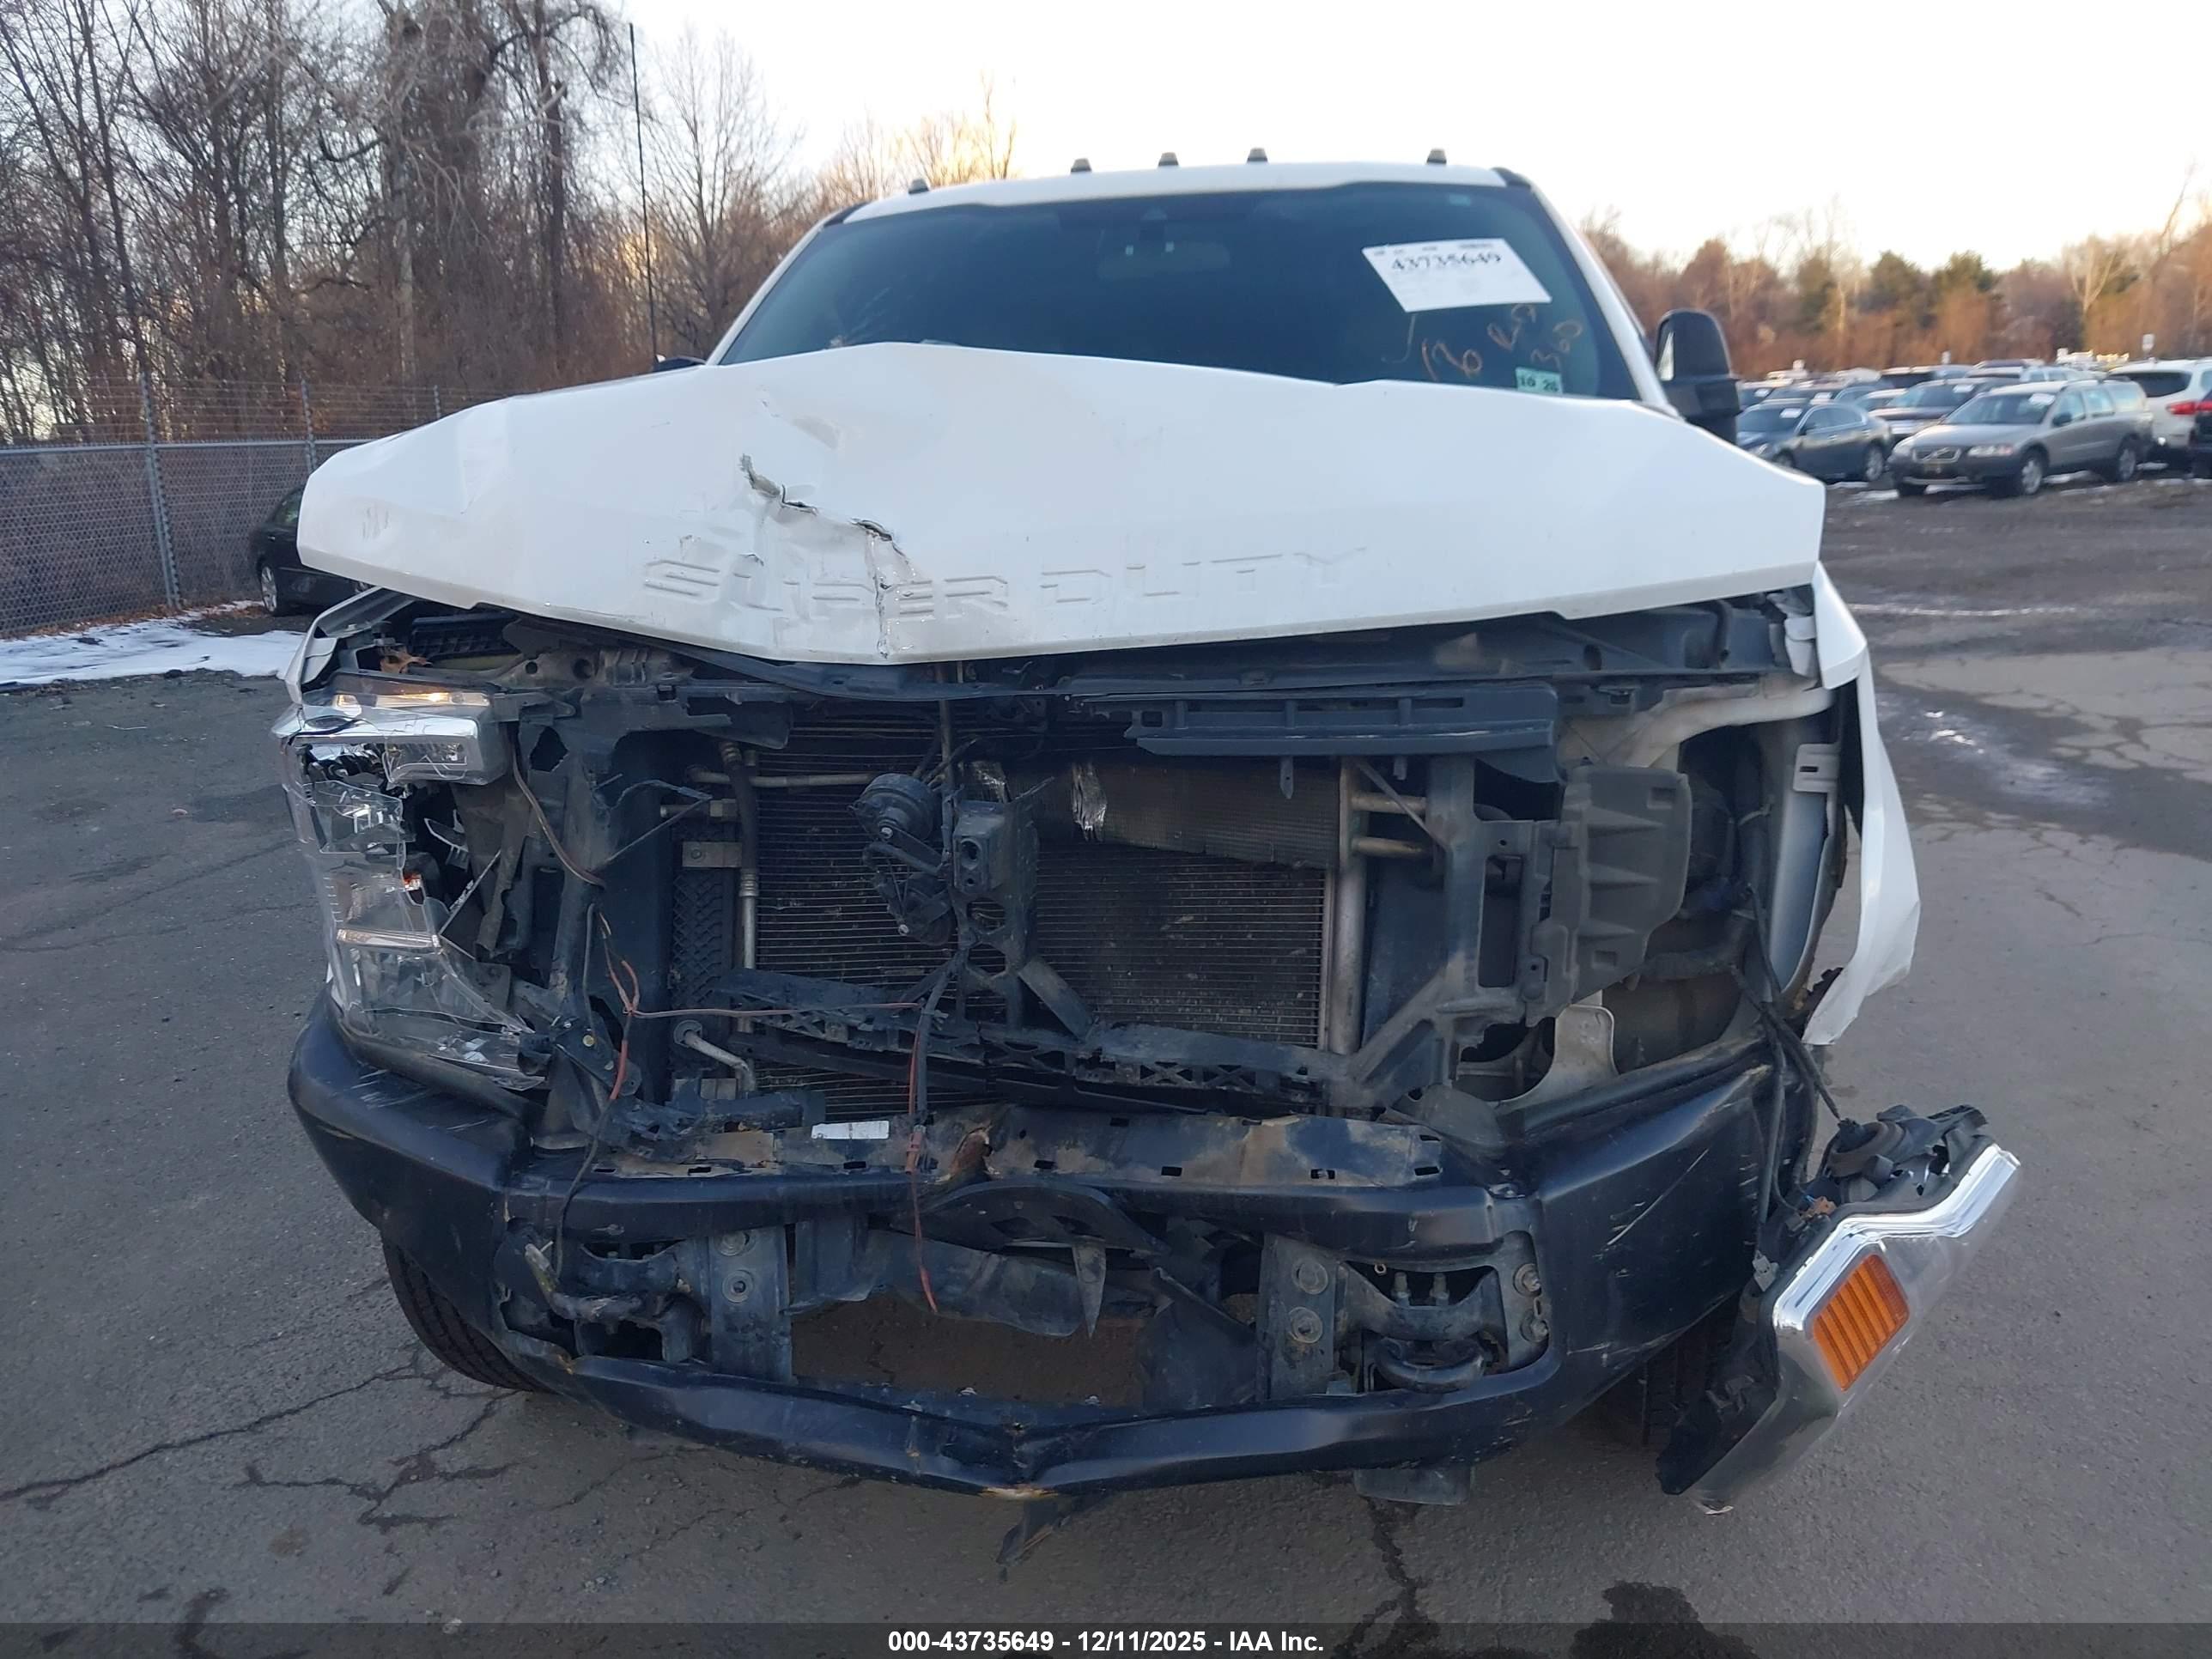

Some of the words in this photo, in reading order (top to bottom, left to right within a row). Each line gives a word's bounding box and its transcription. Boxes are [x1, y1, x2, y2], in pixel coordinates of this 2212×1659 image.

[1391, 252, 1502, 272] 43735649
[643, 555, 1011, 620] SUPER
[1039, 547, 1367, 605] DUTY
